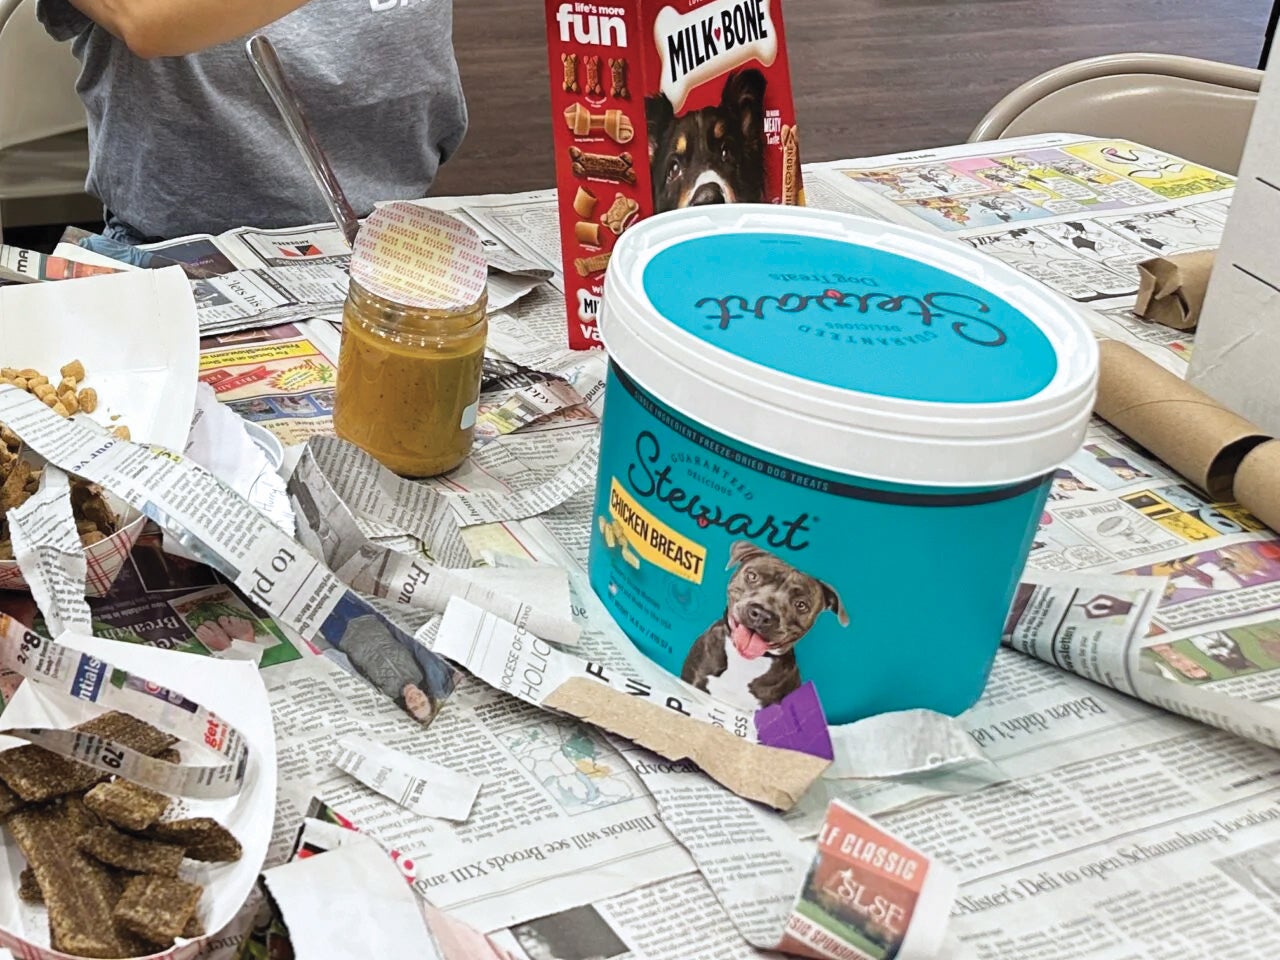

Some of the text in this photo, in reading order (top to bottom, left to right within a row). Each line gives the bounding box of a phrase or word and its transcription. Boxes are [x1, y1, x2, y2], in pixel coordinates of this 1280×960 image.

[574, 2, 625, 15] life's more
[557, 3, 628, 48] fun
[667, 16, 715, 83] MILK
[768, 273, 878, 289] Dog Treats
[694, 291, 1008, 349] Stewart
[795, 323, 939, 347] GUARANTEED
[823, 320, 903, 334] DELICIOUS
[654, 408, 830, 492] INGREDIENT FREEZE-DRIED DOG TREATS
[628, 430, 811, 552] Stewart
[670, 451, 755, 502] GUARANTEED
[687, 468, 733, 498] DELICIOUS
[610, 488, 704, 576] CHICKEN BREAST
[269, 548, 296, 573] to
[996, 696, 1105, 737] Biden didn't
[569, 828, 601, 850] will
[601, 814, 656, 840] Illinois
[486, 845, 545, 867] Broods
[546, 838, 571, 853] see
[840, 832, 918, 881] CLASSIC
[449, 862, 489, 885] XIII
[1023, 875, 1058, 898] Deli
[1058, 870, 1077, 886] to
[1077, 859, 1123, 885] open
[1121, 828, 1216, 868] Schaumburg
